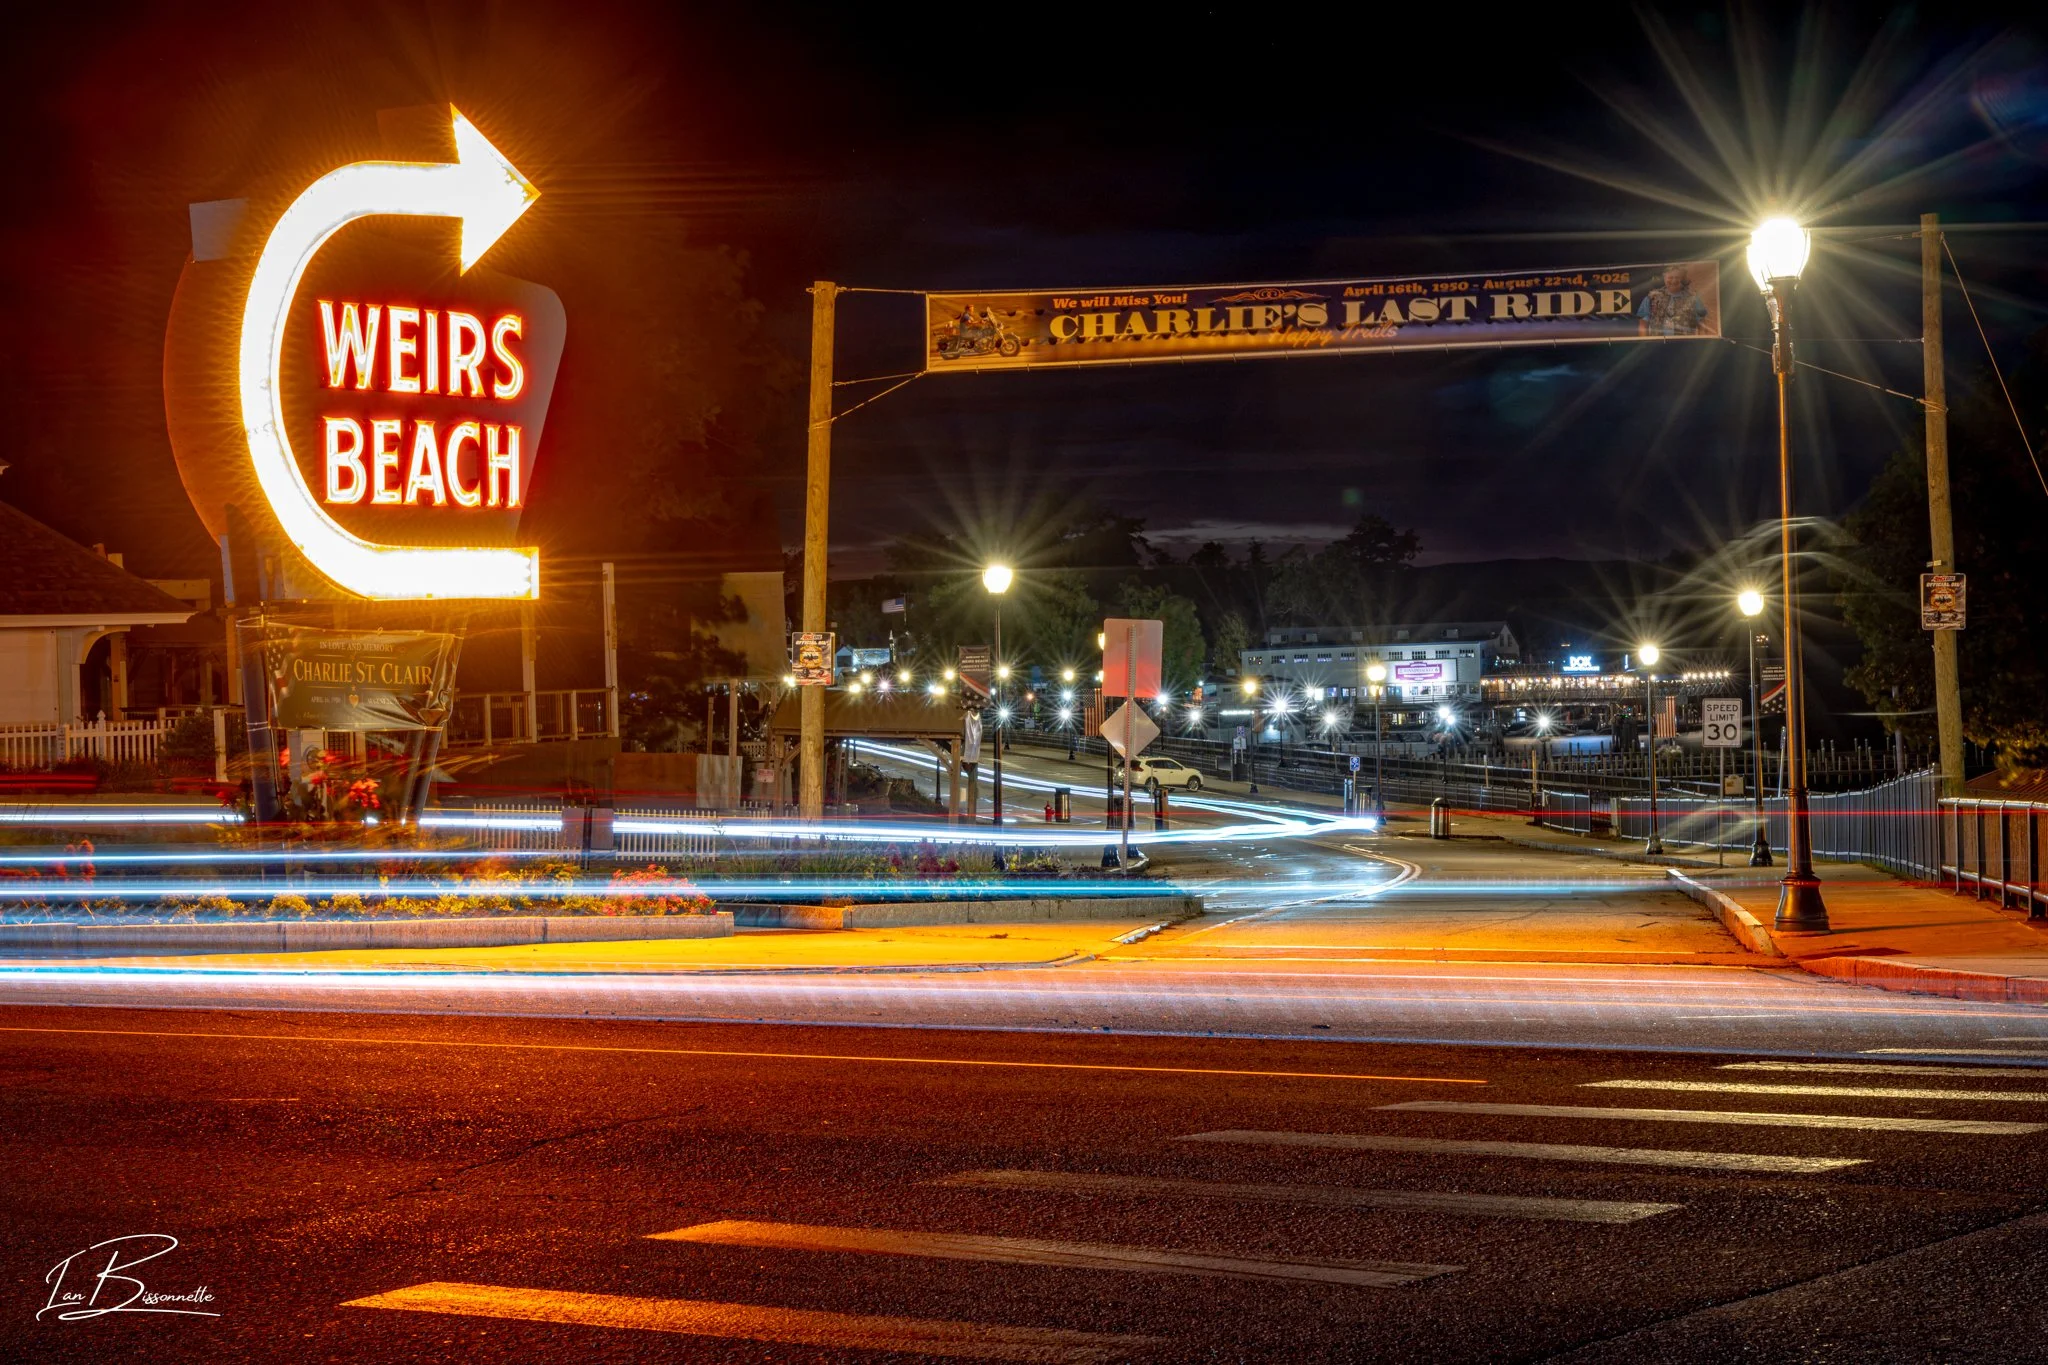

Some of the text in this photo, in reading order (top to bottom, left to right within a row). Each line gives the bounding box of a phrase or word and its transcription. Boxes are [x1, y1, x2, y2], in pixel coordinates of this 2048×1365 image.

[1343, 284, 1384, 297] April
[1432, 281, 1469, 292] 1950
[1482, 277, 1541, 291] August
[1053, 293, 1188, 309] We will Miss You!
[1050, 289, 1632, 339] CHARLIE'S LAST RIDE
[1267, 320, 1398, 347] Happy Trails
[317, 299, 525, 400] WEIRS
[322, 416, 524, 508] BEACH
[319, 641, 393, 652] IN LOVE AND MEMORY
[294, 659, 432, 685] CHARLIE ST. CLAIR
[1706, 704, 1738, 712] SPEED
[1707, 724, 1737, 740] 30
